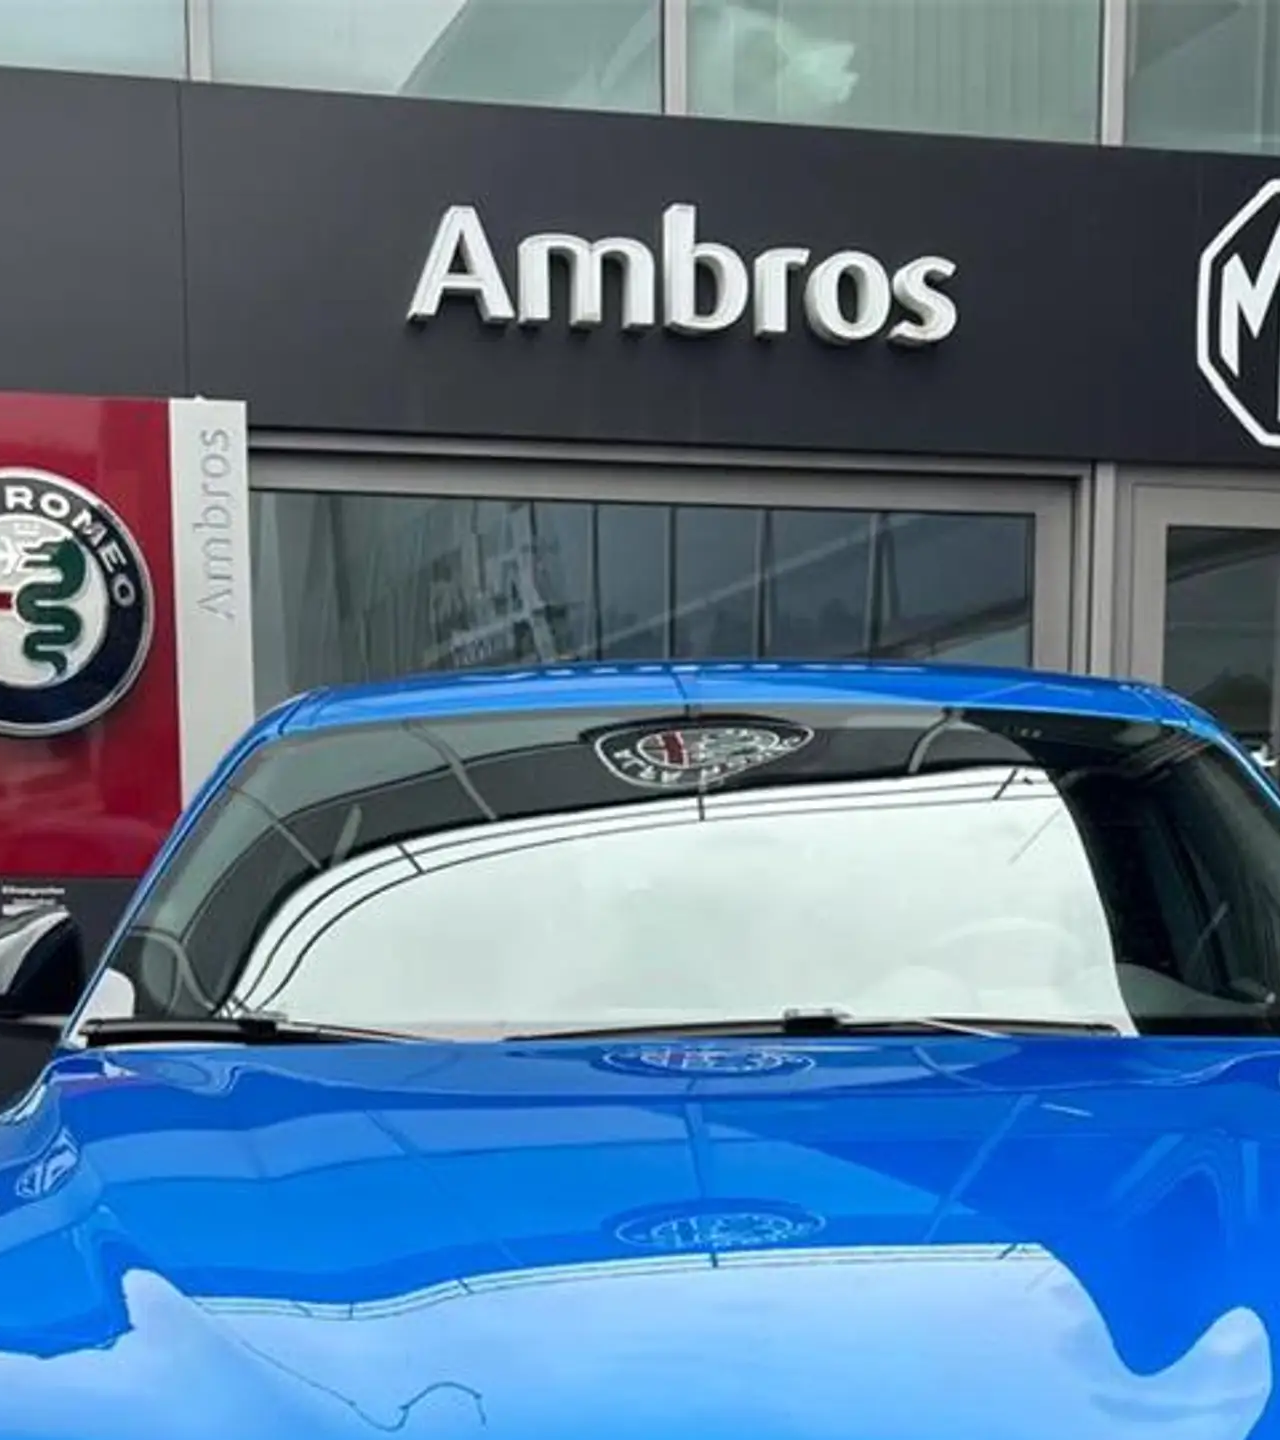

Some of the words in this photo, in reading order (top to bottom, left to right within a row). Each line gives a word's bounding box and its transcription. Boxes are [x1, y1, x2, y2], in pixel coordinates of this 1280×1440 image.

[405, 203, 957, 347] Ambros
[5, 484, 137, 607] ROMEO
[197, 428, 234, 621] Ambros
